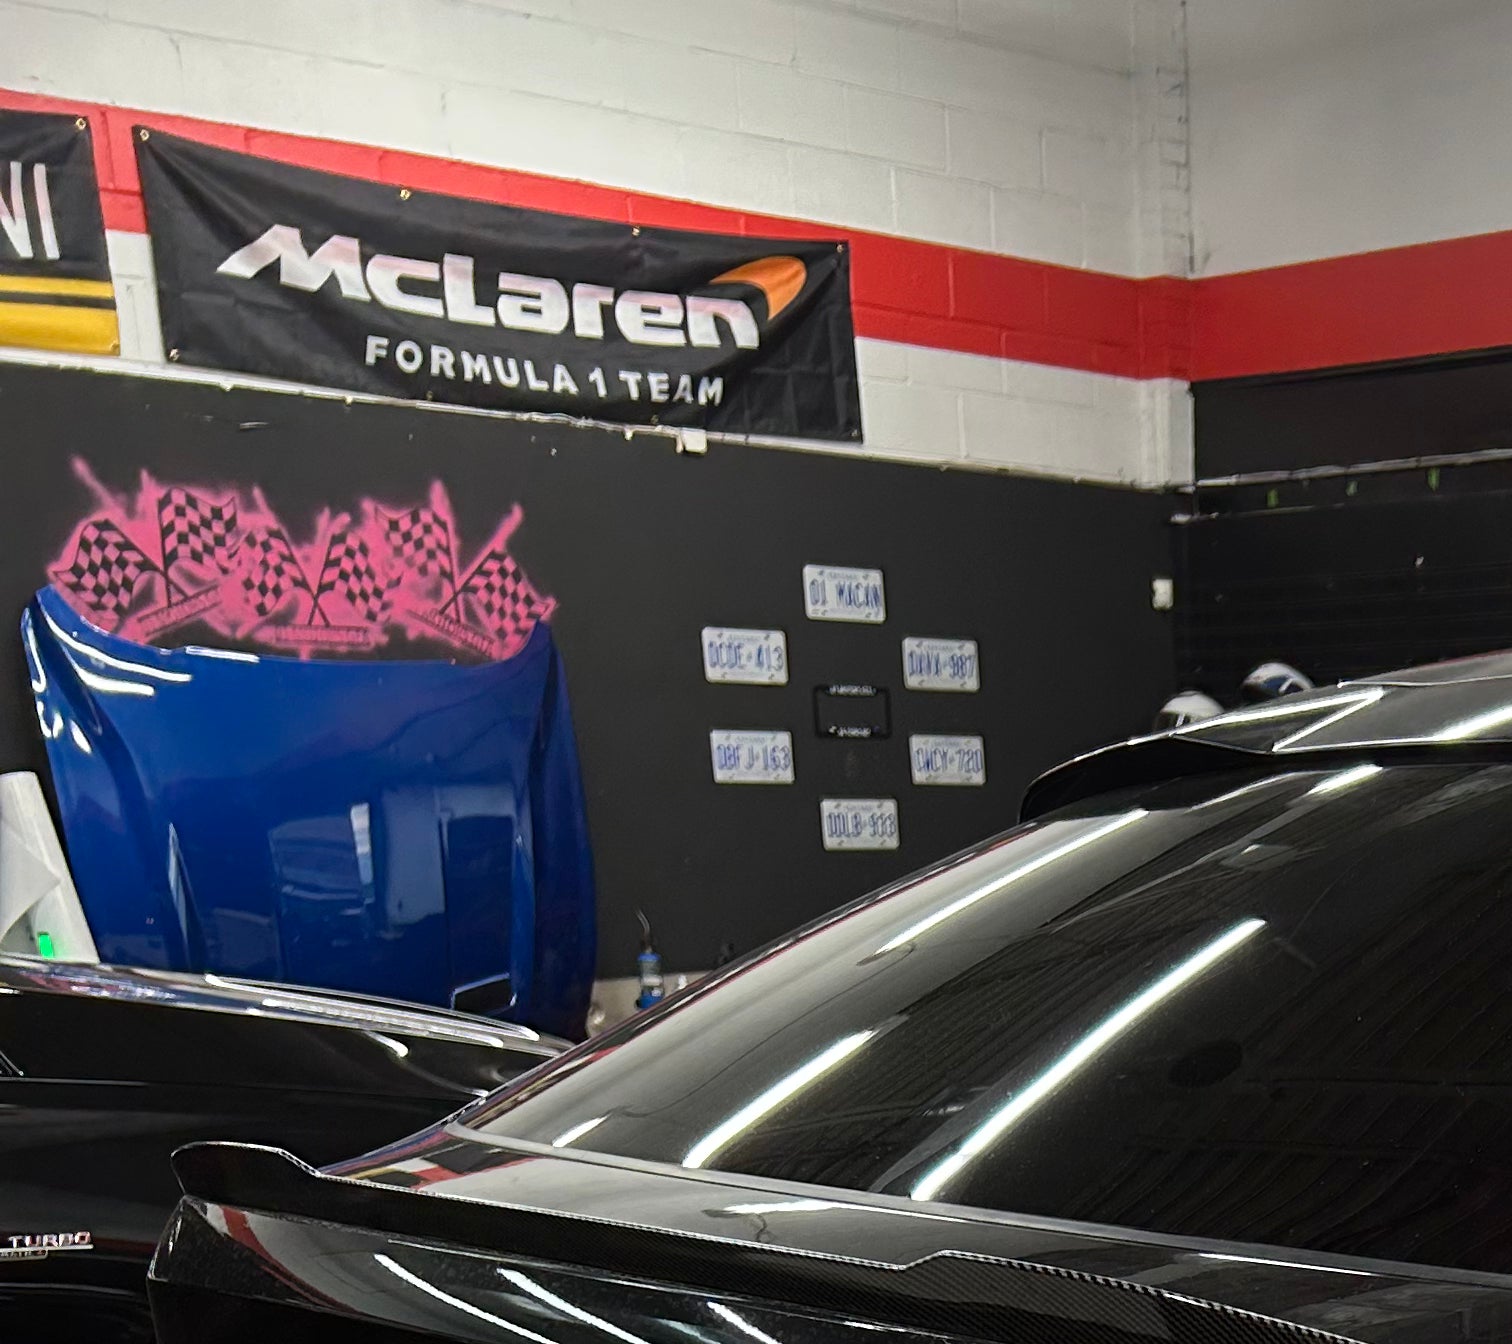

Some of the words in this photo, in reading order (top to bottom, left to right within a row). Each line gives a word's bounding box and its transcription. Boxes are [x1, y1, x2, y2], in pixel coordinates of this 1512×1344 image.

[216, 224, 760, 350] McLaren
[365, 335, 579, 395] FORMULA
[588, 367, 607, 398] 1
[618, 370, 723, 406] TEAM
